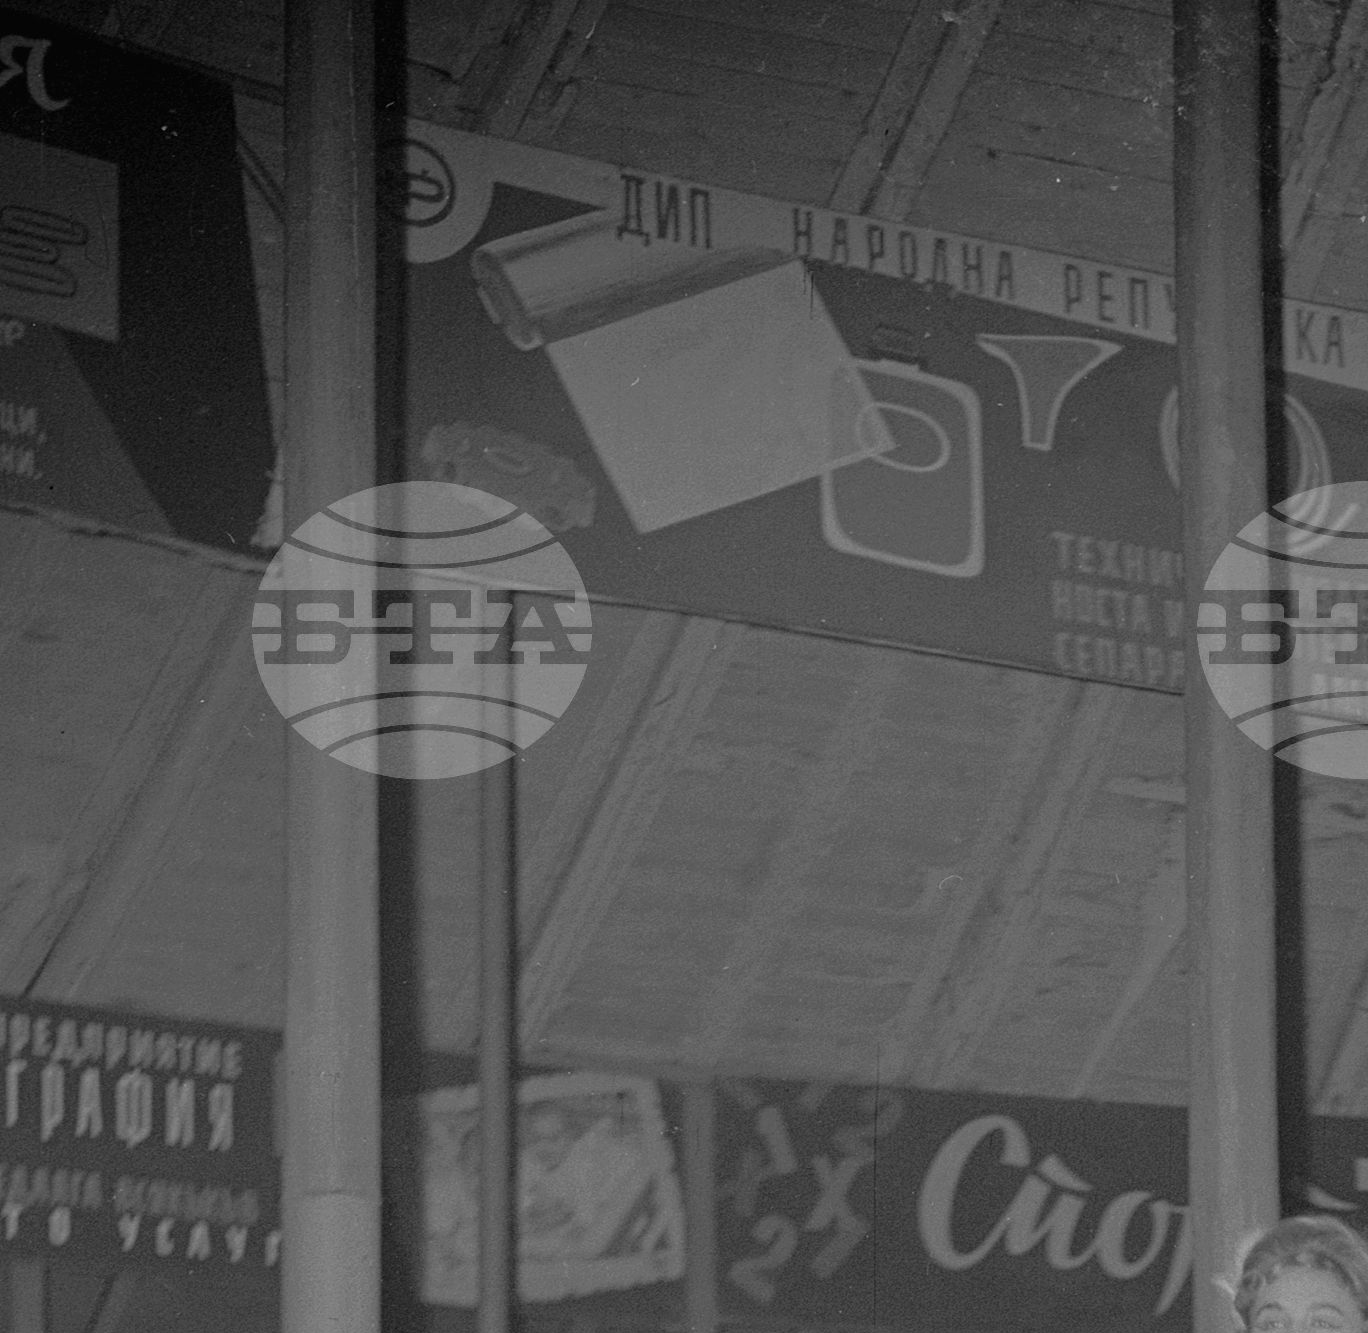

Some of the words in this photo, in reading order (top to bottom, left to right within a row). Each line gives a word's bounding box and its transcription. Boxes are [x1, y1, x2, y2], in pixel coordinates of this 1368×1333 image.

[617, 174, 712, 249] ДИП
[793, 207, 1015, 300] НАРОДНА
[0, 1013, 242, 1080] РЕДПРИЯТИЕ
[5, 1059, 235, 1151] ГРАФИЯ
